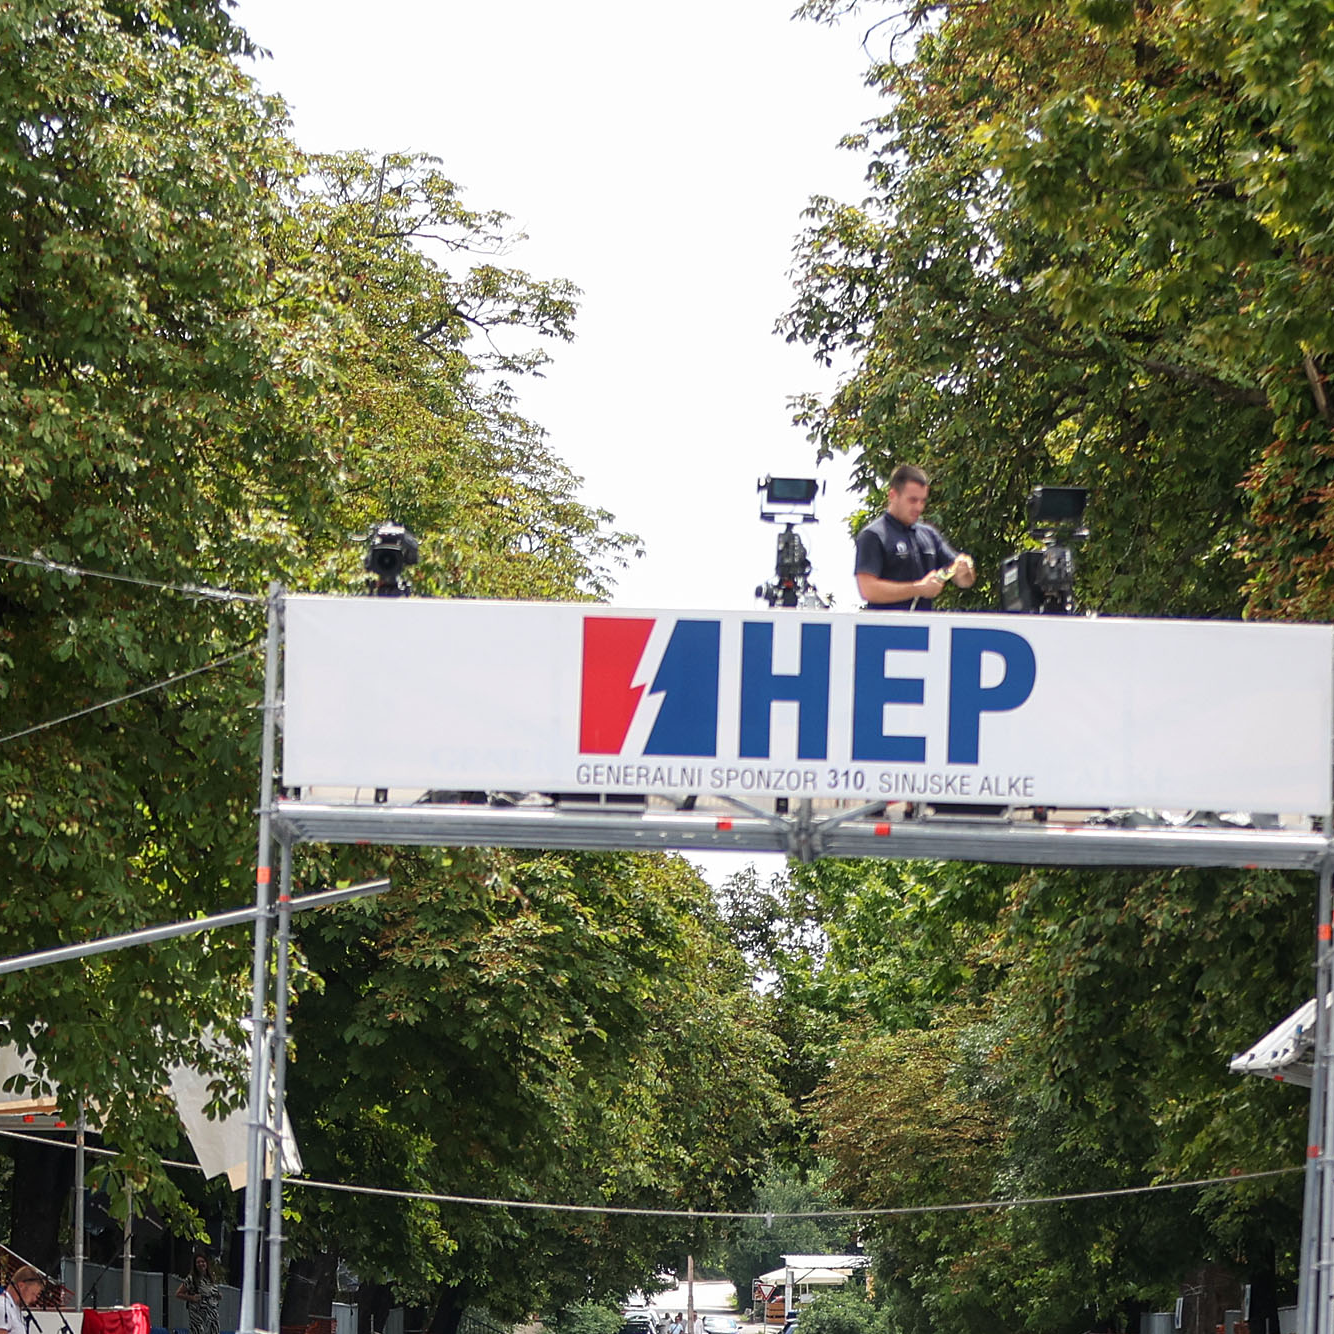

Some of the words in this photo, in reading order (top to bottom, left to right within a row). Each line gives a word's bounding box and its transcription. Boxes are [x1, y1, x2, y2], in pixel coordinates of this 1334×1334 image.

[739, 621, 1038, 765] HEP
[576, 763, 704, 789] GENERALNI
[710, 767, 818, 792] SPONZOR
[878, 772, 972, 796] SINJSKE
[978, 775, 1035, 798] ALKE
